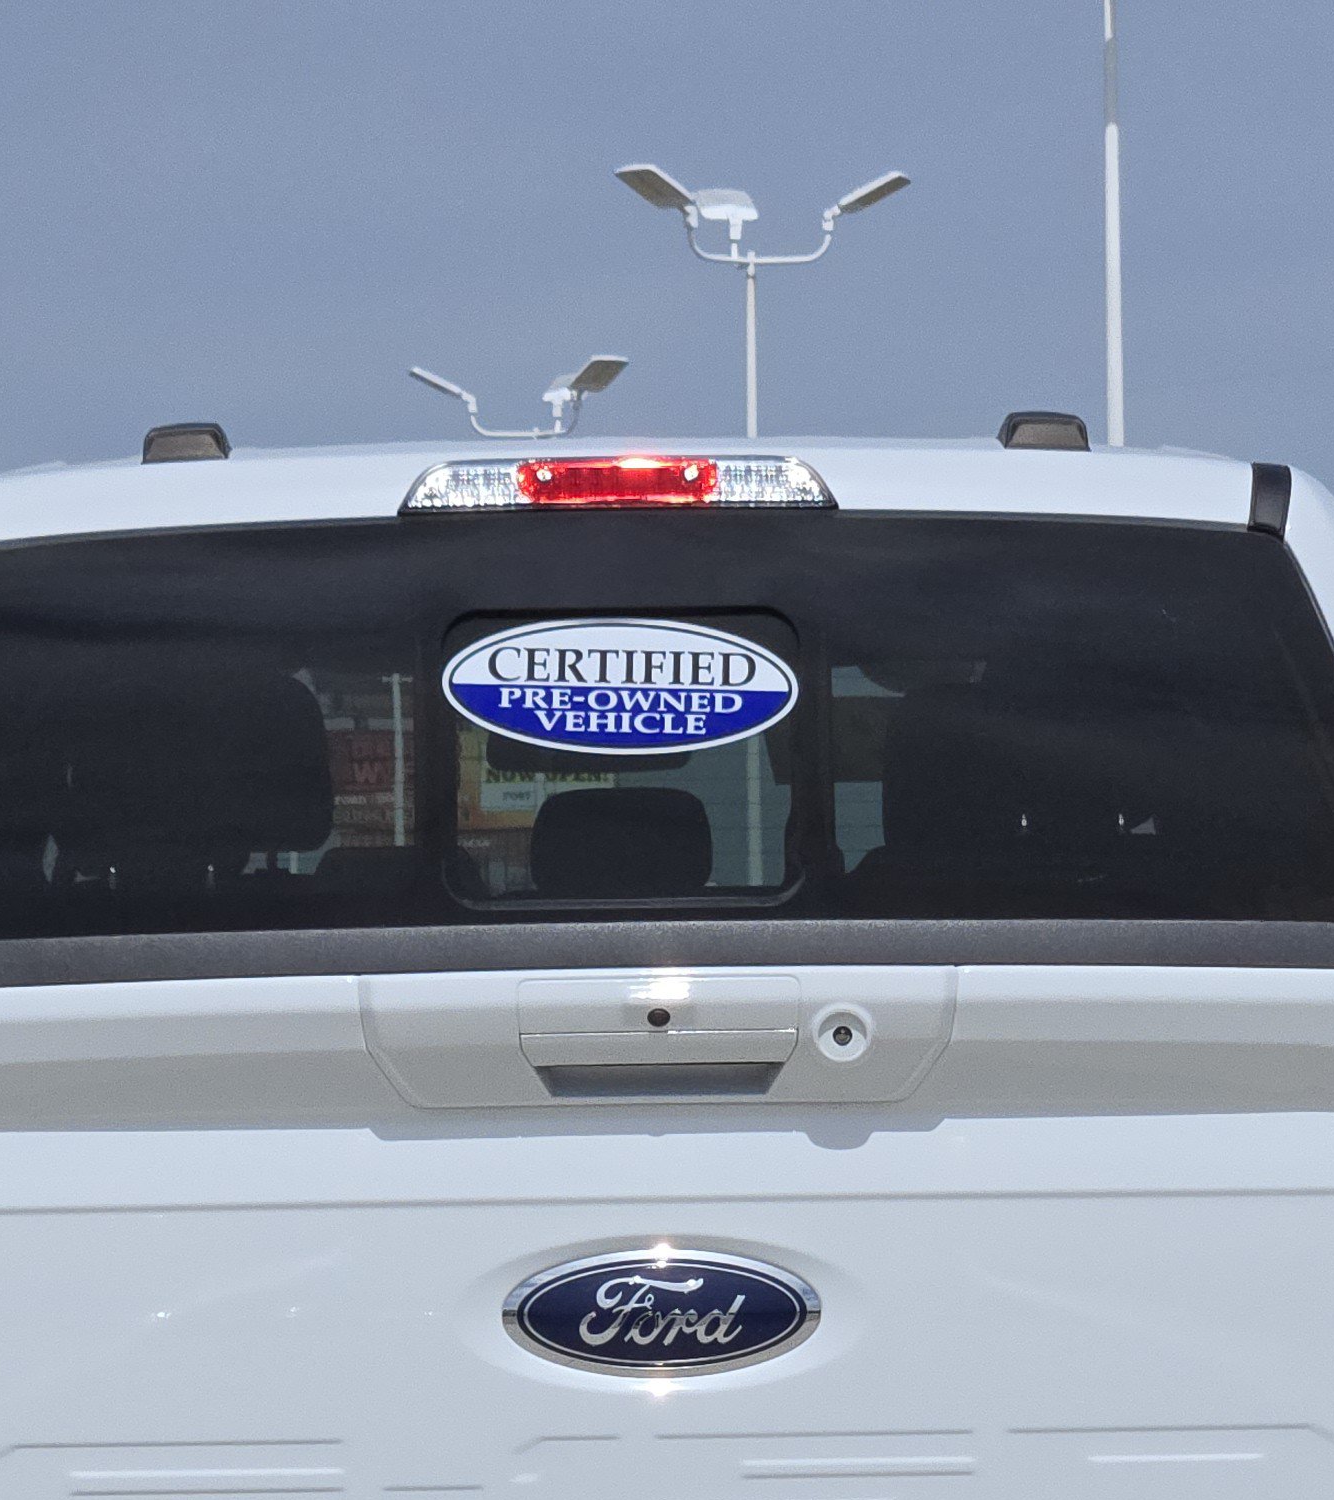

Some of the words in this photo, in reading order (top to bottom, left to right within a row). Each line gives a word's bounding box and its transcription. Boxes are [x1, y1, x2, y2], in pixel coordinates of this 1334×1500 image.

[487, 646, 757, 689] CERTIFIED
[497, 686, 744, 714] PRE-OWNED
[535, 709, 708, 736] VEHICLE
[578, 1274, 747, 1347] Ford
